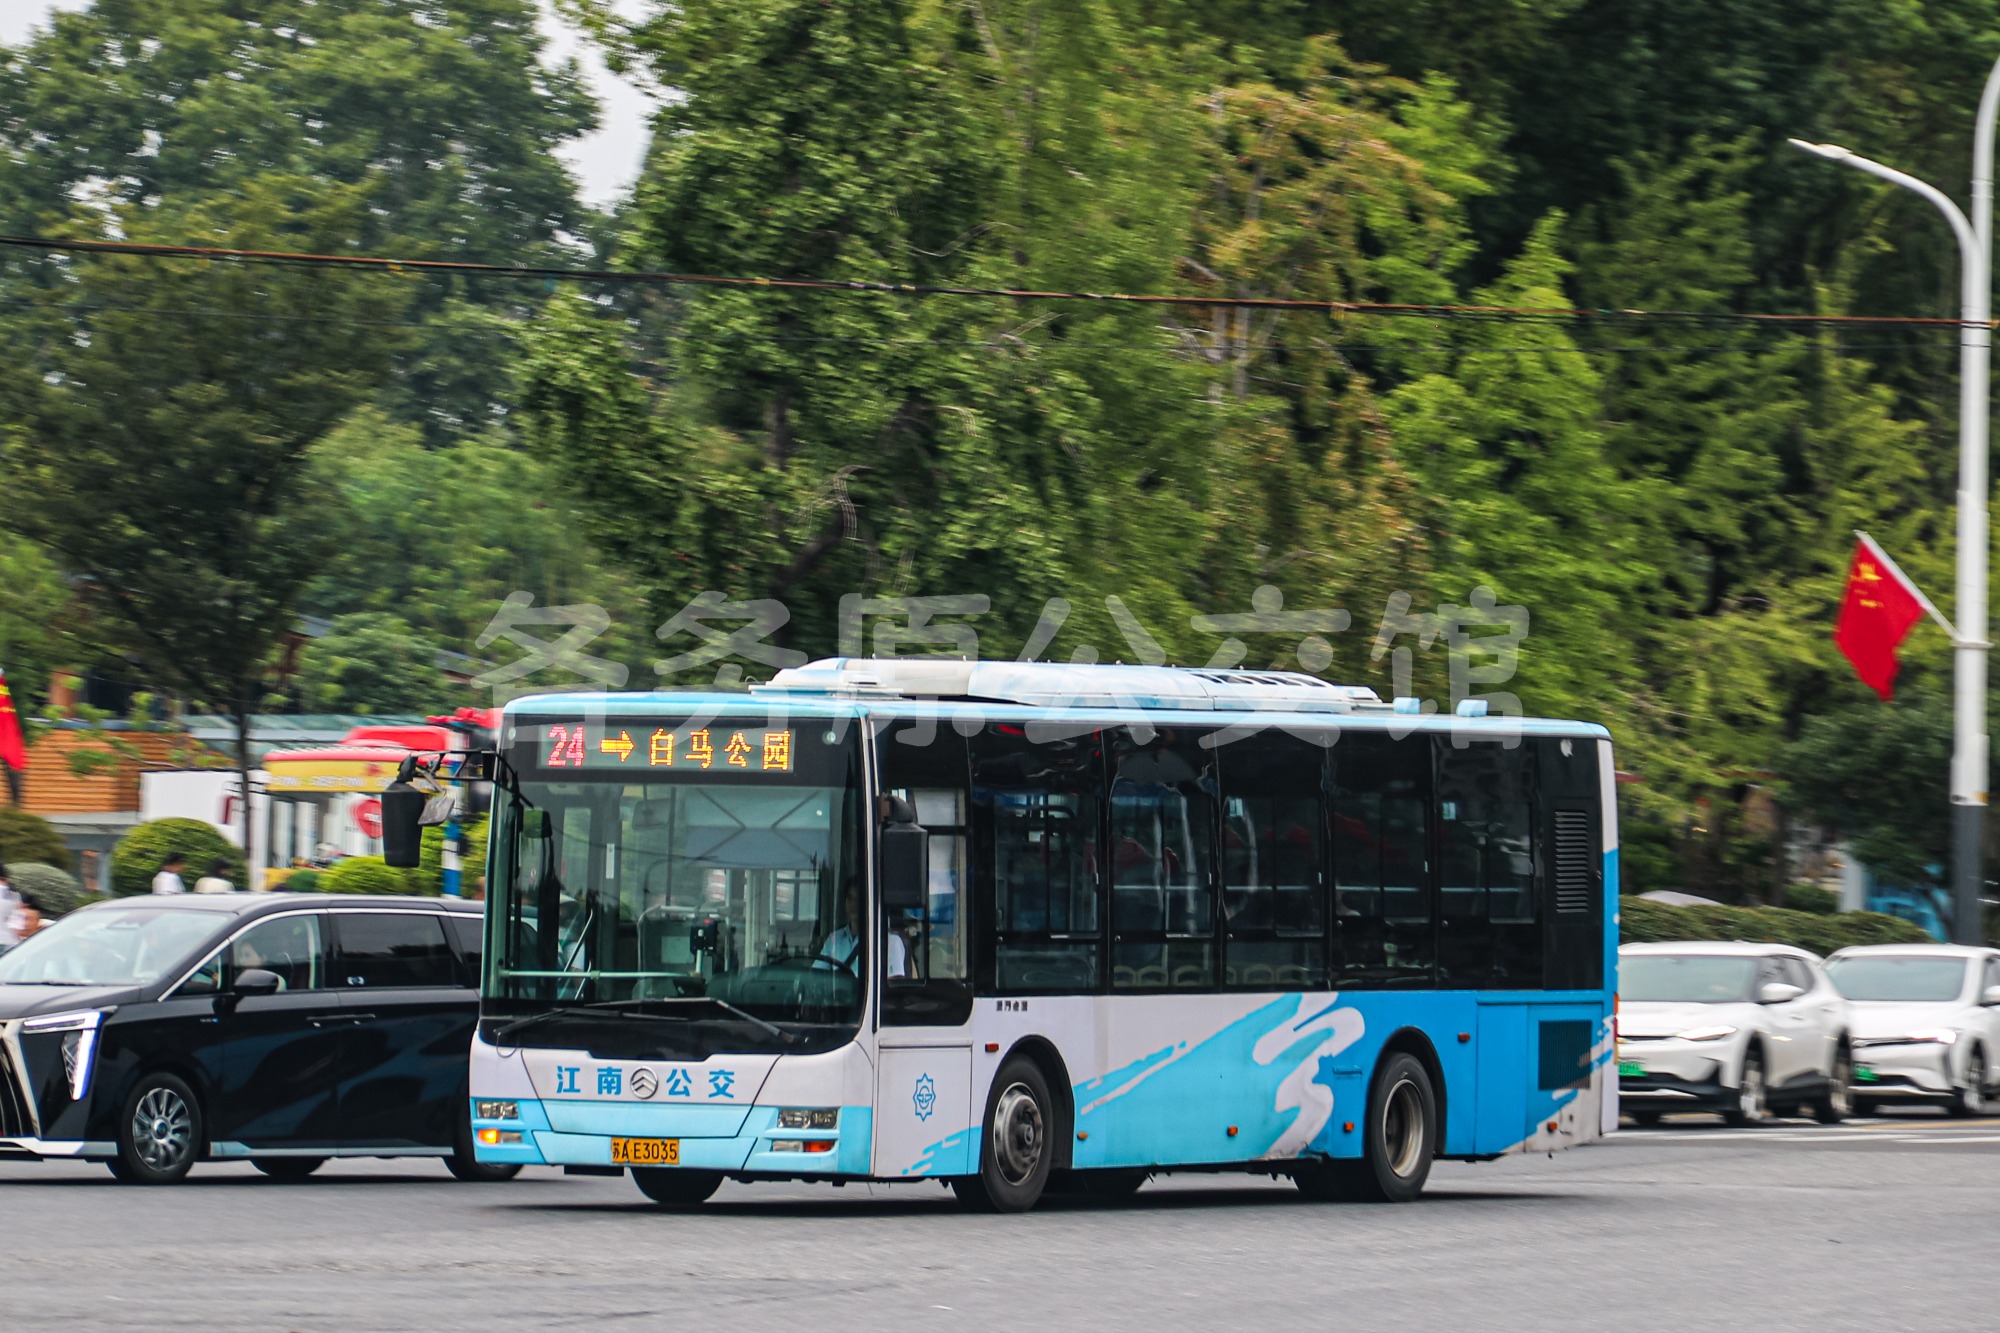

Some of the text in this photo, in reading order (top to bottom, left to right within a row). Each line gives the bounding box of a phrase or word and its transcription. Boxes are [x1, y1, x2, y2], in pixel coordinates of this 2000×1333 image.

[548, 726, 792, 770] 24 白马公园
